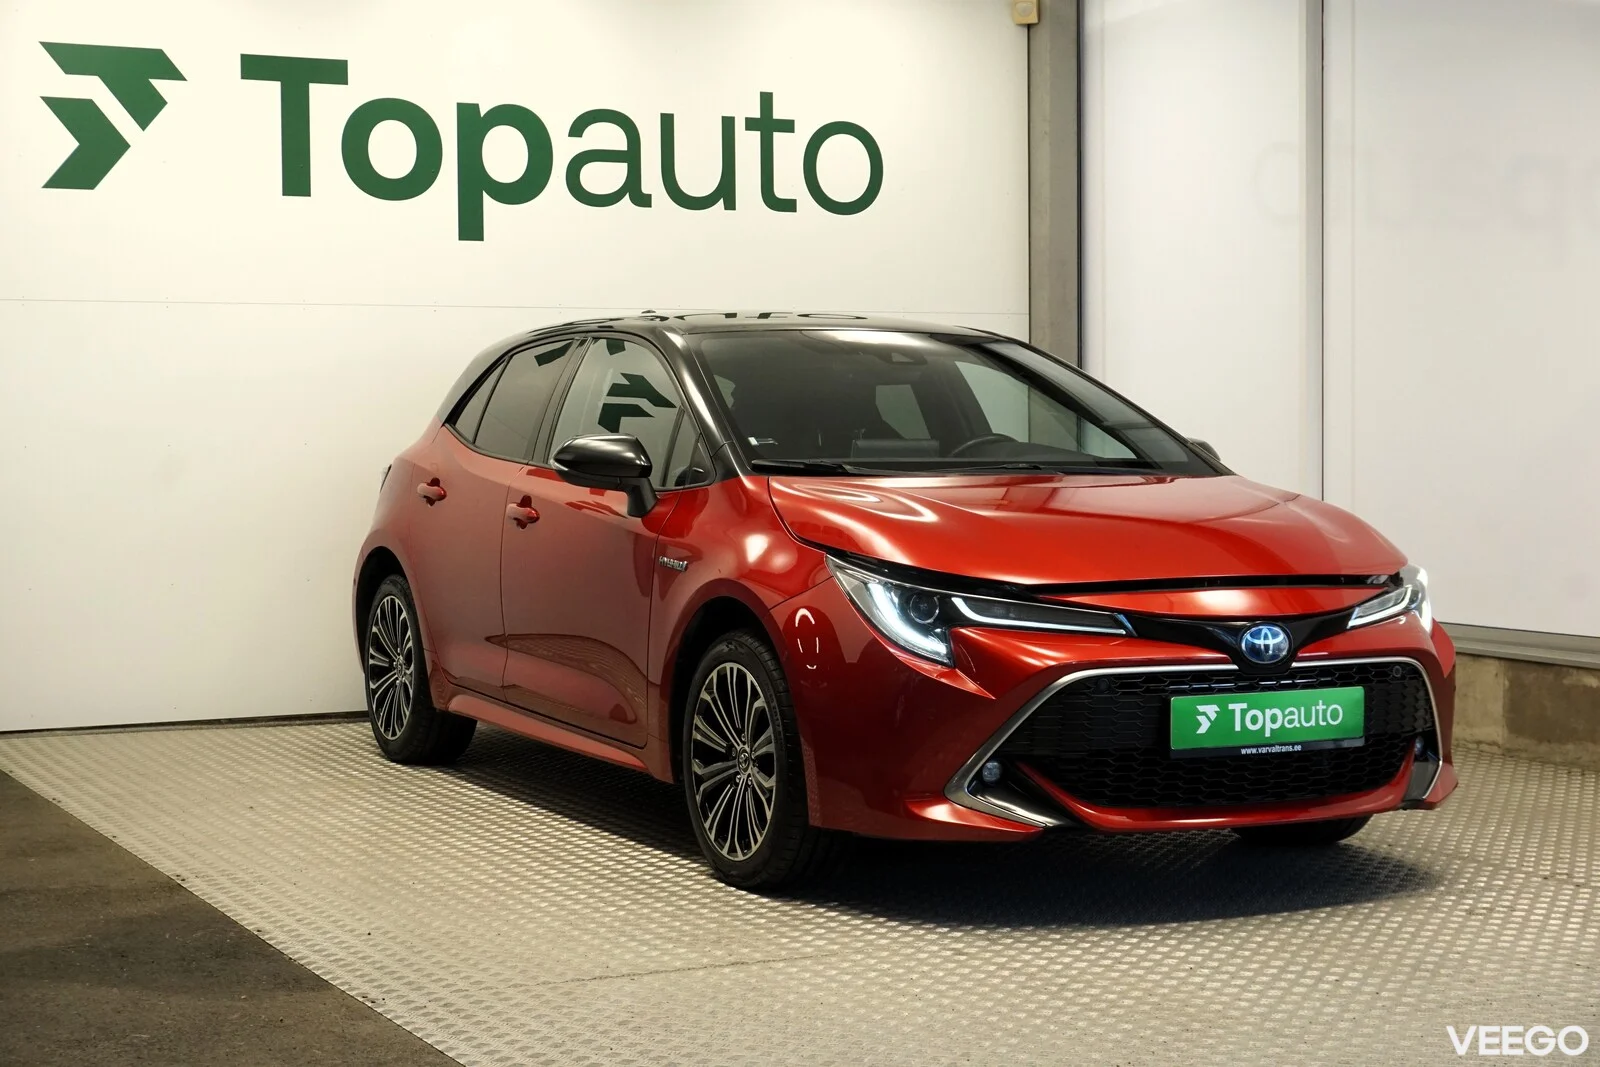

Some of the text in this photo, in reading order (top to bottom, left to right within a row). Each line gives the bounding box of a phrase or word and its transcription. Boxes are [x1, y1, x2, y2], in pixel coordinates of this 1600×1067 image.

[240, 54, 883, 241] Topauto
[1228, 700, 1343, 737] Topauto
[1240, 744, 1302, 755] www.varvaltrans.ee
